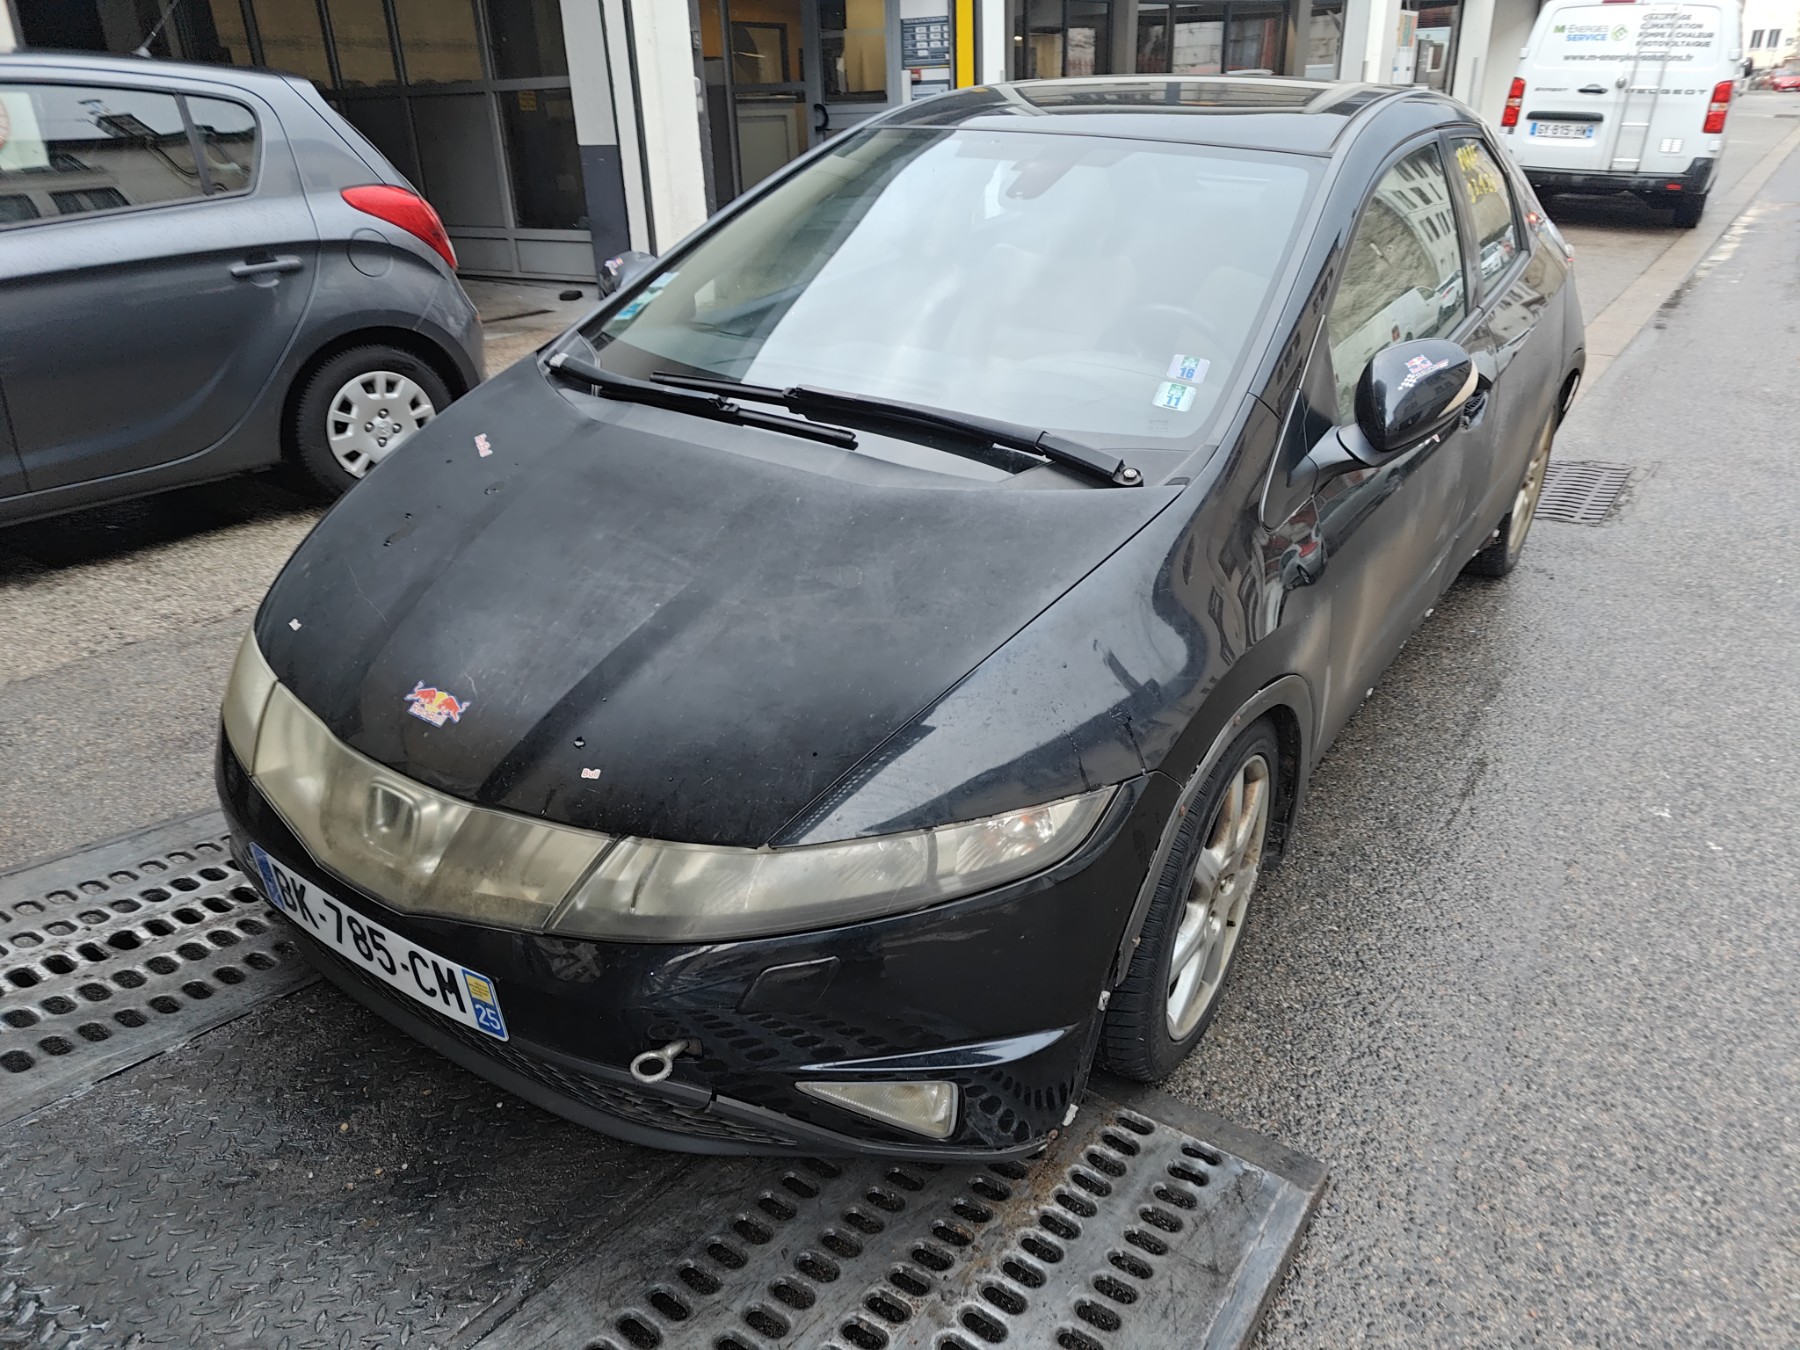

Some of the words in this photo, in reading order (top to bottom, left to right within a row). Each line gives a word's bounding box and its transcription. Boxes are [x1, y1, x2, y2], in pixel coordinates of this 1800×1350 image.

[1566, 33, 1608, 42] SERVICE
[1180, 367, 1195, 378] 16
[1167, 395, 1181, 407] 11
[582, 769, 600, 778] Bull
[272, 863, 467, 1014] BK-785-CM
[475, 1003, 501, 1030] 25
